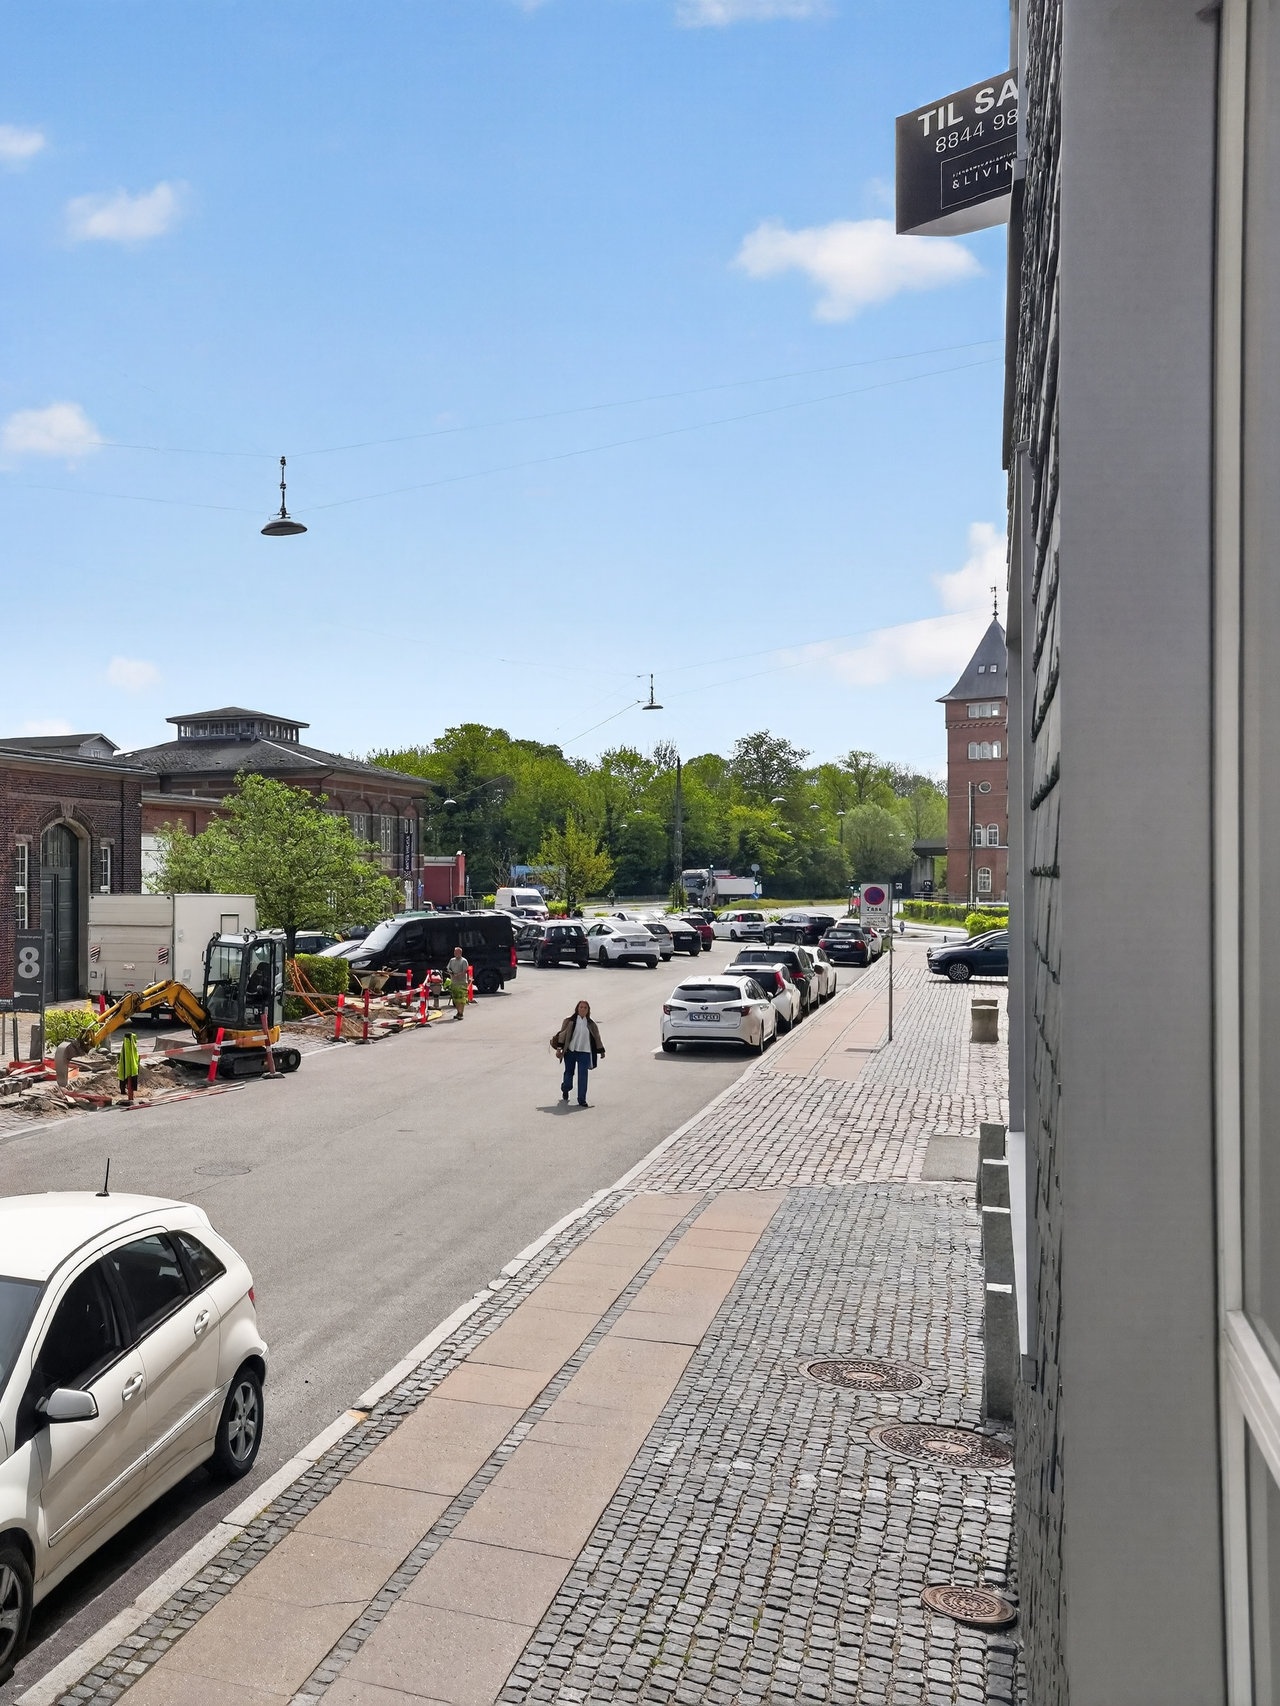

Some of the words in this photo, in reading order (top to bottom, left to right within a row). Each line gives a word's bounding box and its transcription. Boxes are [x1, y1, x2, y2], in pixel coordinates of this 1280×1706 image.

[917, 102, 964, 137] TIL
[935, 121, 985, 153] 8844
[17, 946, 40, 979] 8
